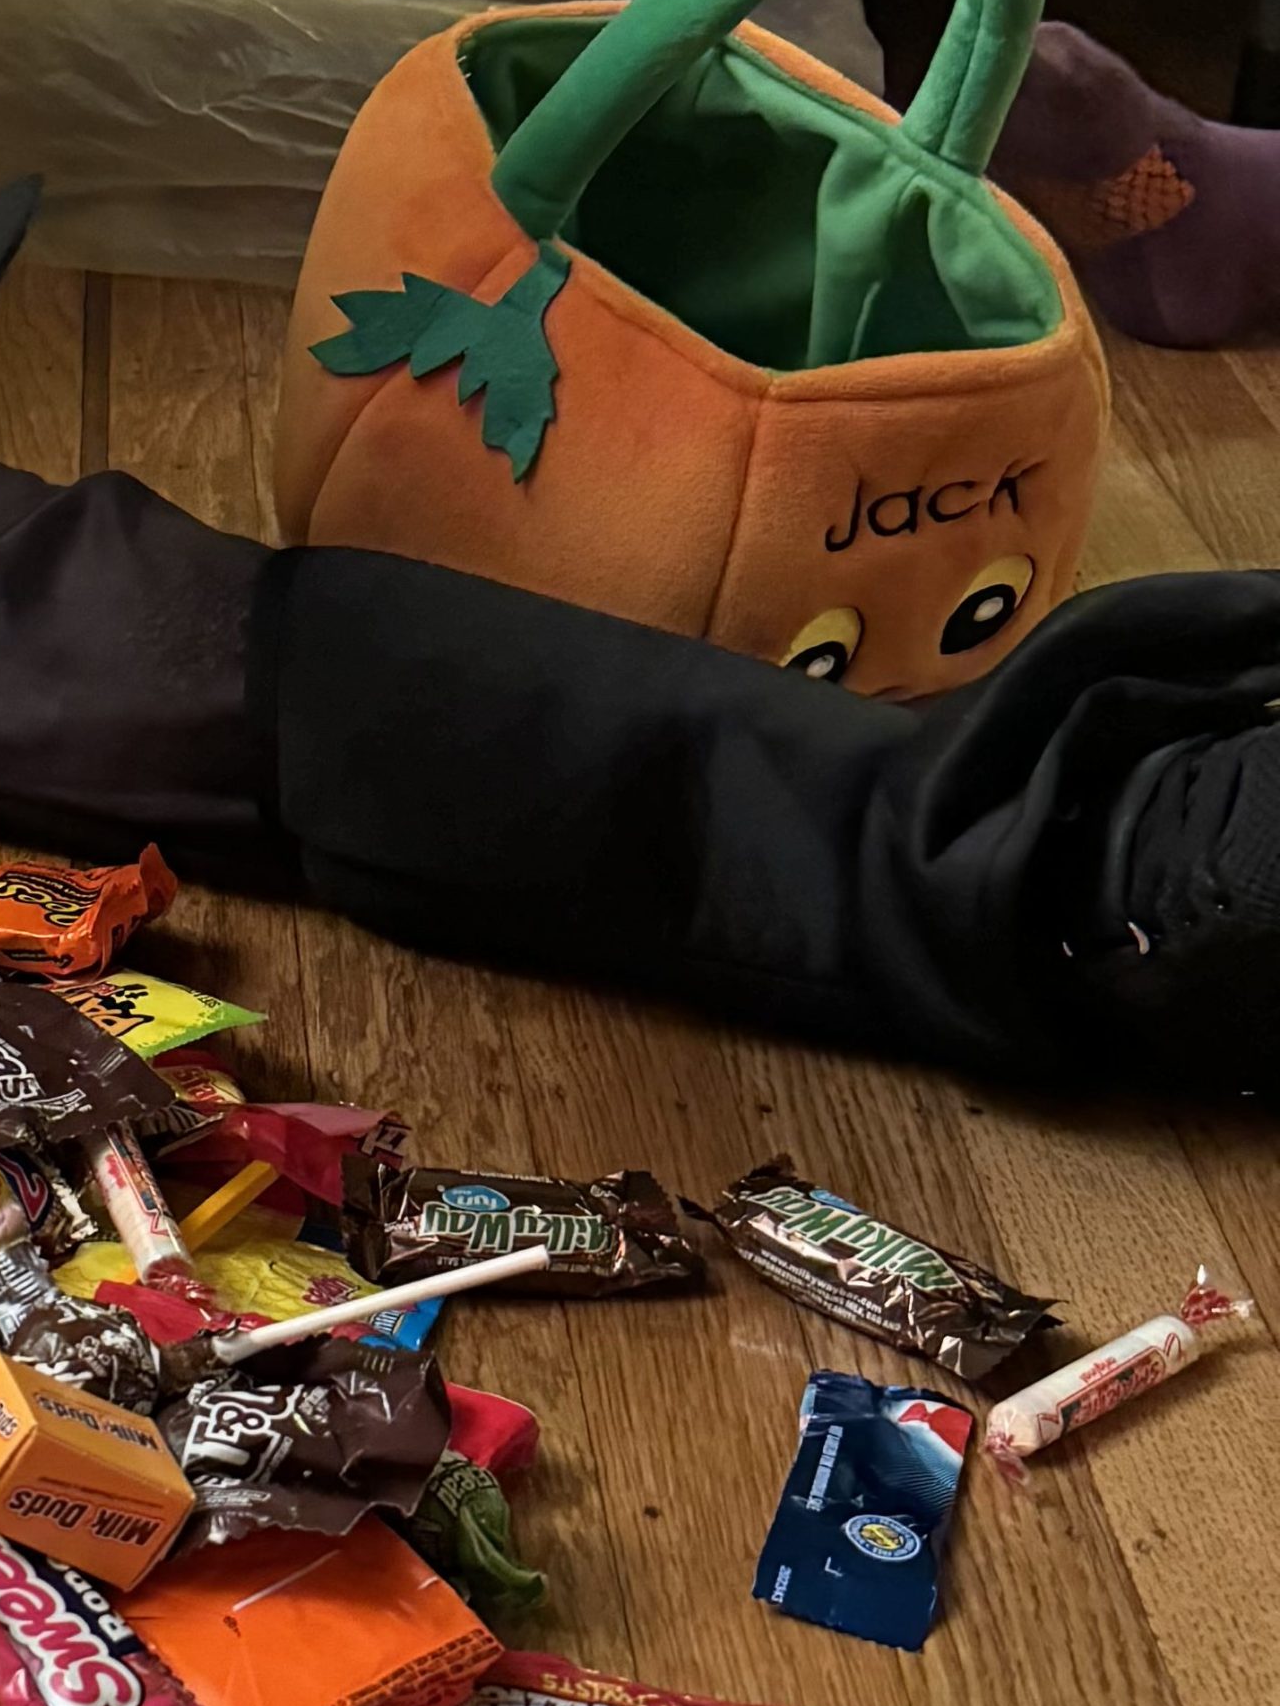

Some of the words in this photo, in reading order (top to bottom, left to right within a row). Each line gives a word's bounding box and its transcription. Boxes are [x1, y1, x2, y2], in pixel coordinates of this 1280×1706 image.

[825, 460, 1045, 552] Jack
[6, 1487, 92, 1531] Duds
[91, 1506, 162, 1549] Milk
